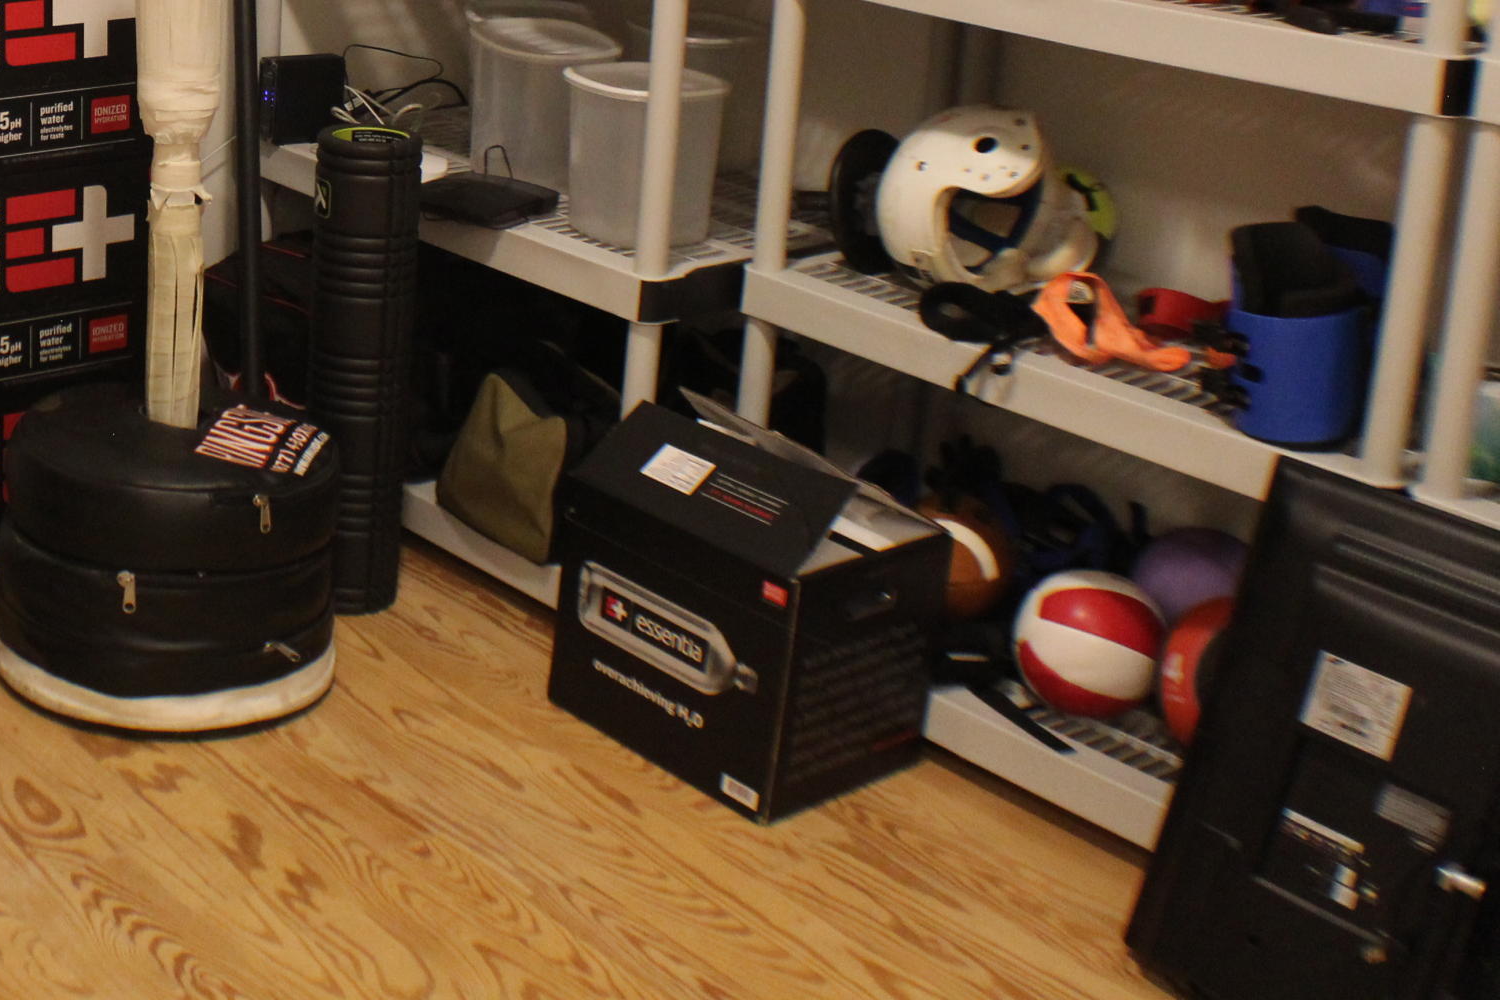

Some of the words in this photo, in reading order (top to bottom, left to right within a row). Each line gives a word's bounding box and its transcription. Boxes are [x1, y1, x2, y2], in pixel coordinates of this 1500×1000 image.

[39, 101, 74, 117] purified
[94, 104, 127, 116] IONIZED
[40, 115, 65, 125] water
[39, 322, 72, 338] purified
[39, 336, 64, 348] water
[635, 614, 704, 663] essentia
[592, 657, 677, 717] overachieving
